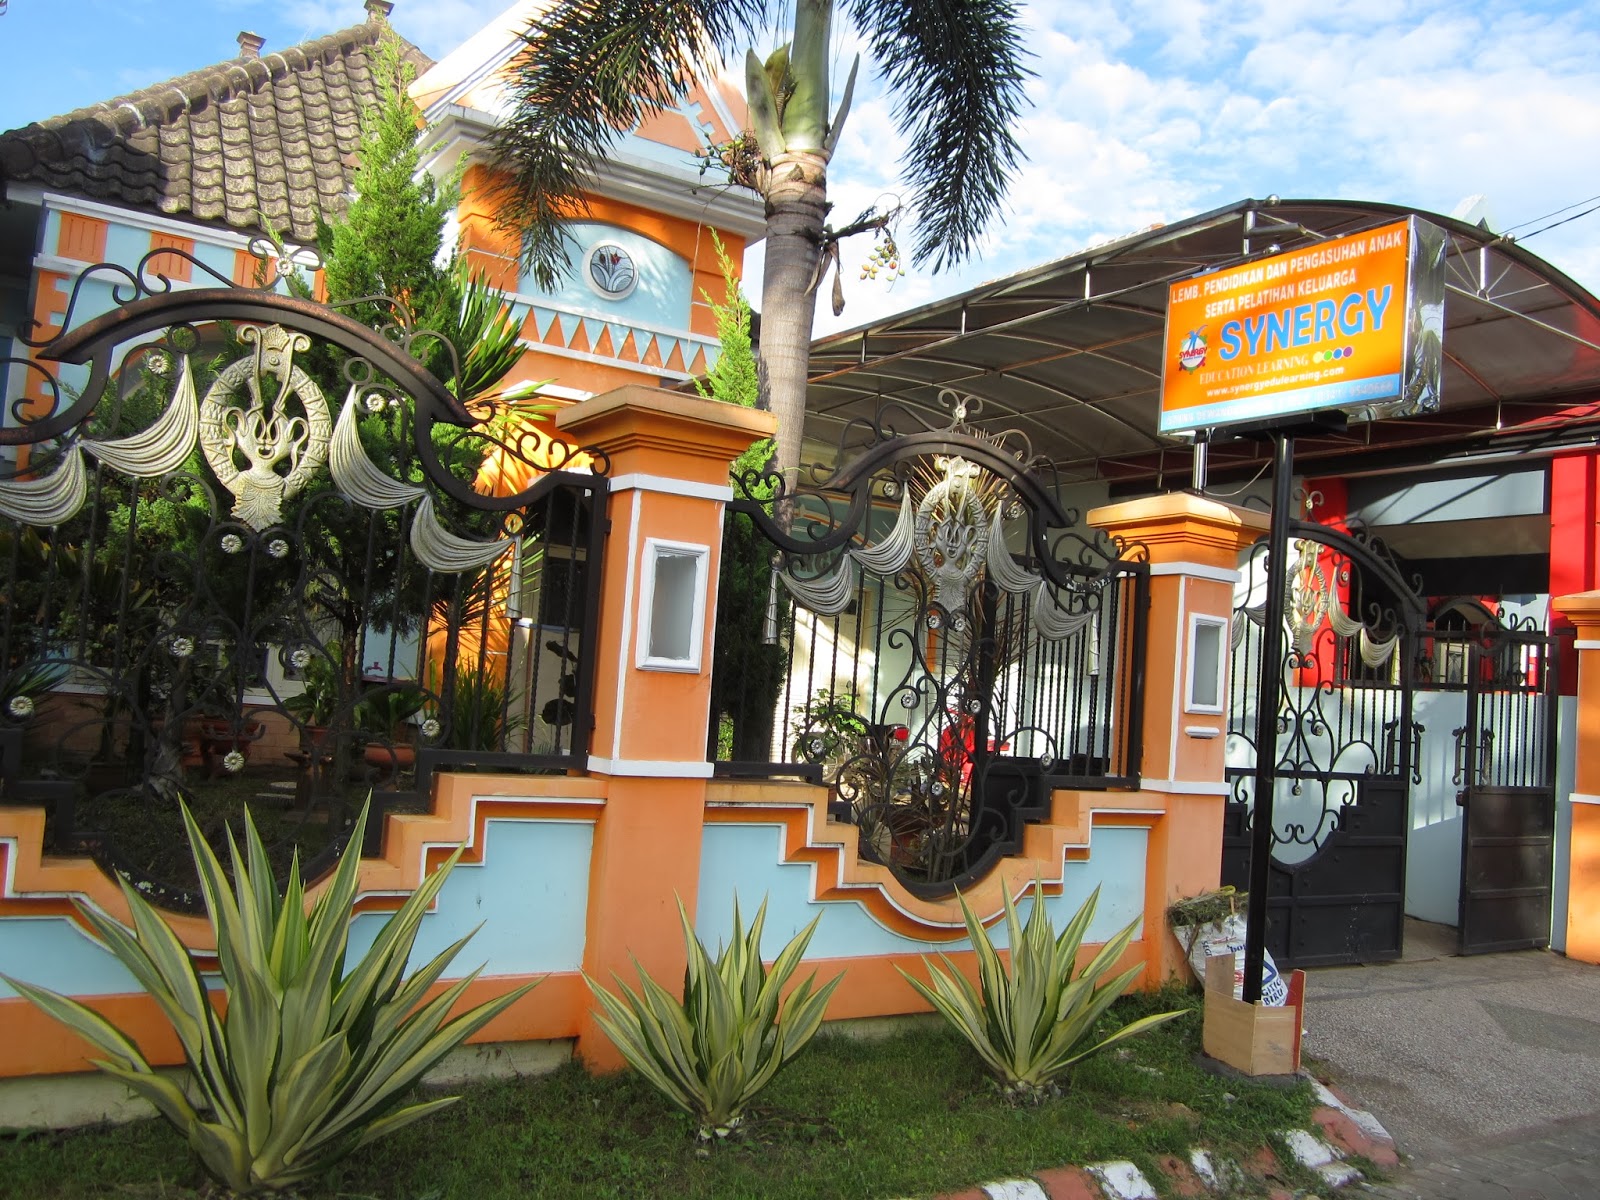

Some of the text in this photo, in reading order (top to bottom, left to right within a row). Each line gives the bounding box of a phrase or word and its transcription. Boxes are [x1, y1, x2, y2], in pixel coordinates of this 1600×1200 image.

[1172, 230, 1402, 304] LEMB. PENDIDIKAN DAN PENGASUHAN ANAK
[1205, 268, 1356, 318] SERTA PELATIHAN KELUARGA
[1219, 284, 1392, 361] SYNERGY
[1199, 352, 1309, 385] EDUCATION LEARNING
[1206, 366, 1344, 397] www.synergyedulearning.com
[1263, 988, 1285, 1006] BIRU
